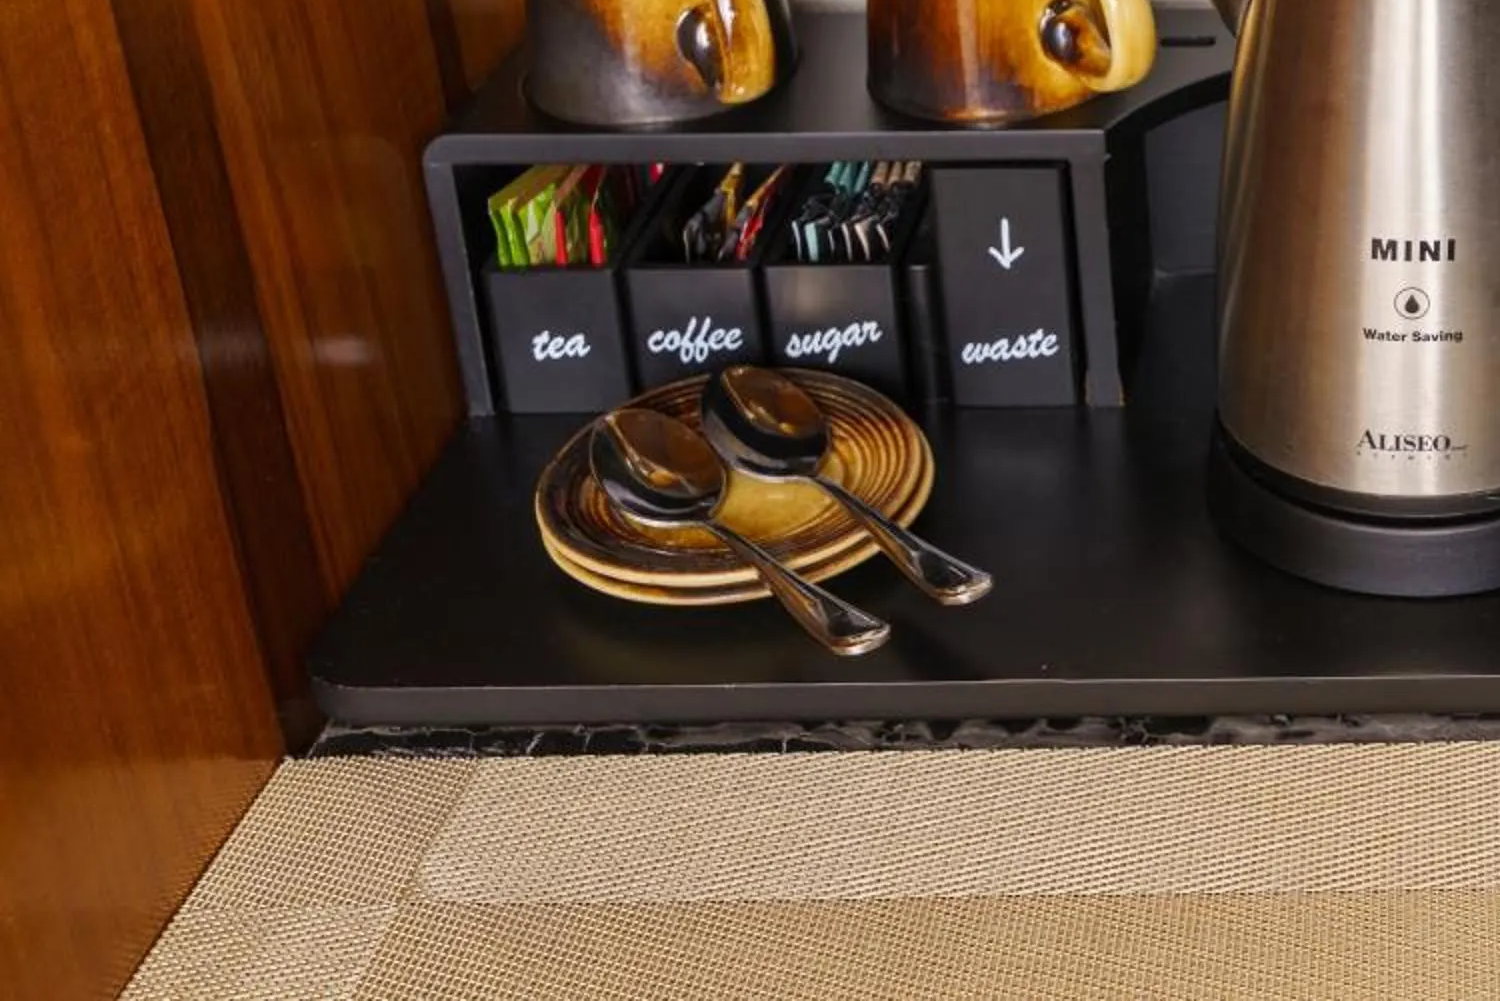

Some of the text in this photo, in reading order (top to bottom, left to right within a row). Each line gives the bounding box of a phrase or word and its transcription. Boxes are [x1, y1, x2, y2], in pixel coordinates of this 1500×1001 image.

[1370, 237, 1457, 262] MINI
[531, 330, 591, 362] tea
[647, 316, 743, 363] coffee
[785, 320, 882, 363] sugar
[961, 328, 1059, 364] waste
[1362, 327, 1464, 344] Water Saving
[1356, 429, 1452, 452] ALISEO
